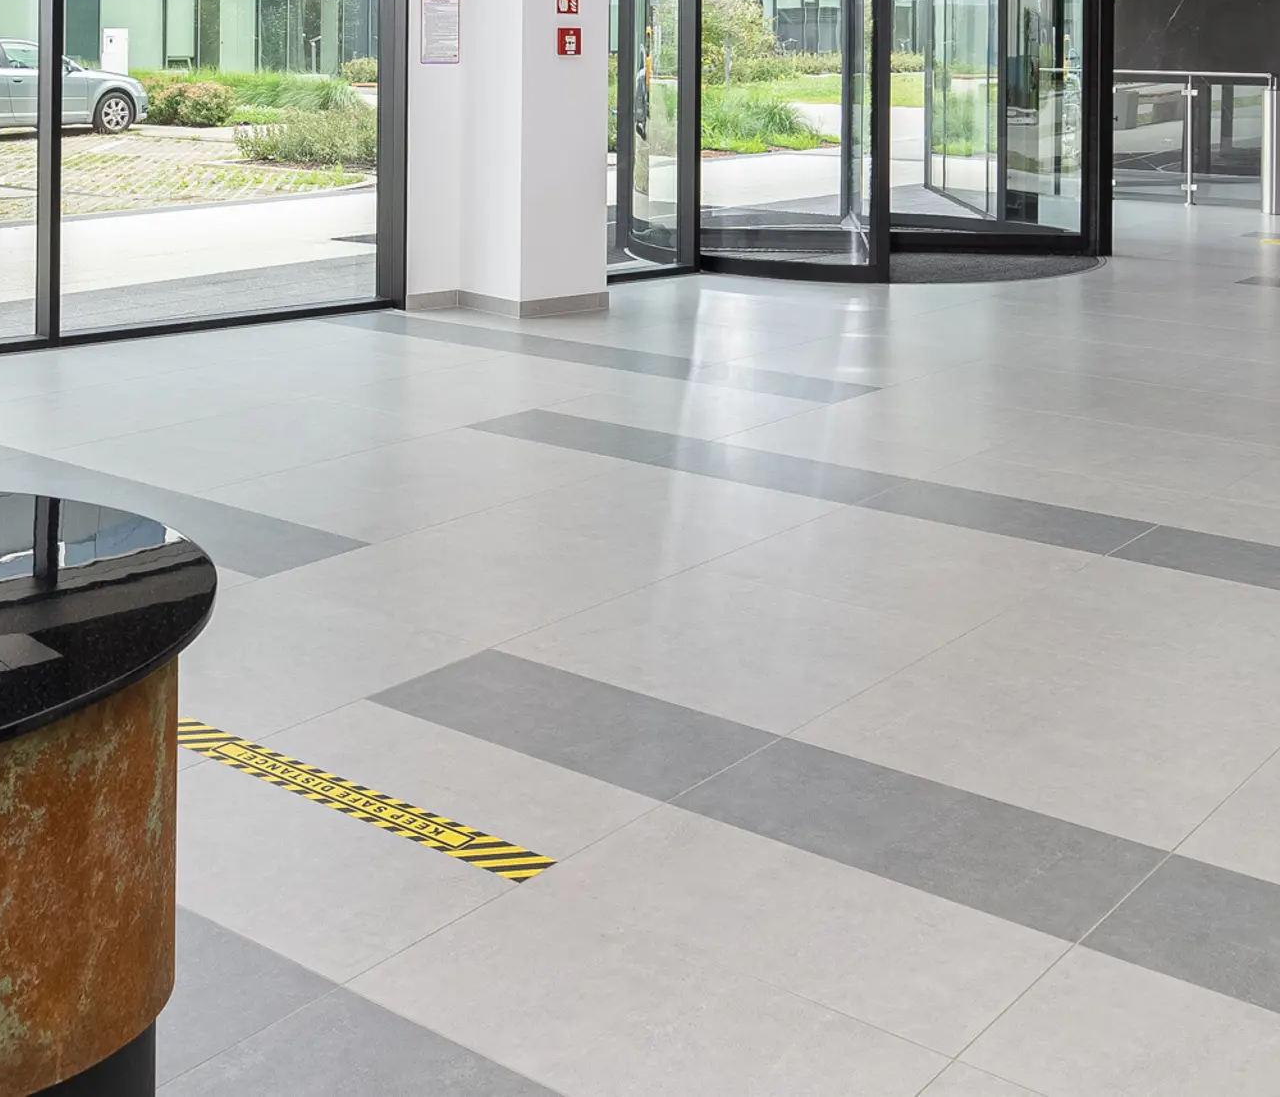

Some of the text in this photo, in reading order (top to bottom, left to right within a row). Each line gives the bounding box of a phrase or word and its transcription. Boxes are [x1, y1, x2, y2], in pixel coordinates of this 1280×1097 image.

[236, 751, 446, 837] KEEP SAFE DISTANCE!
